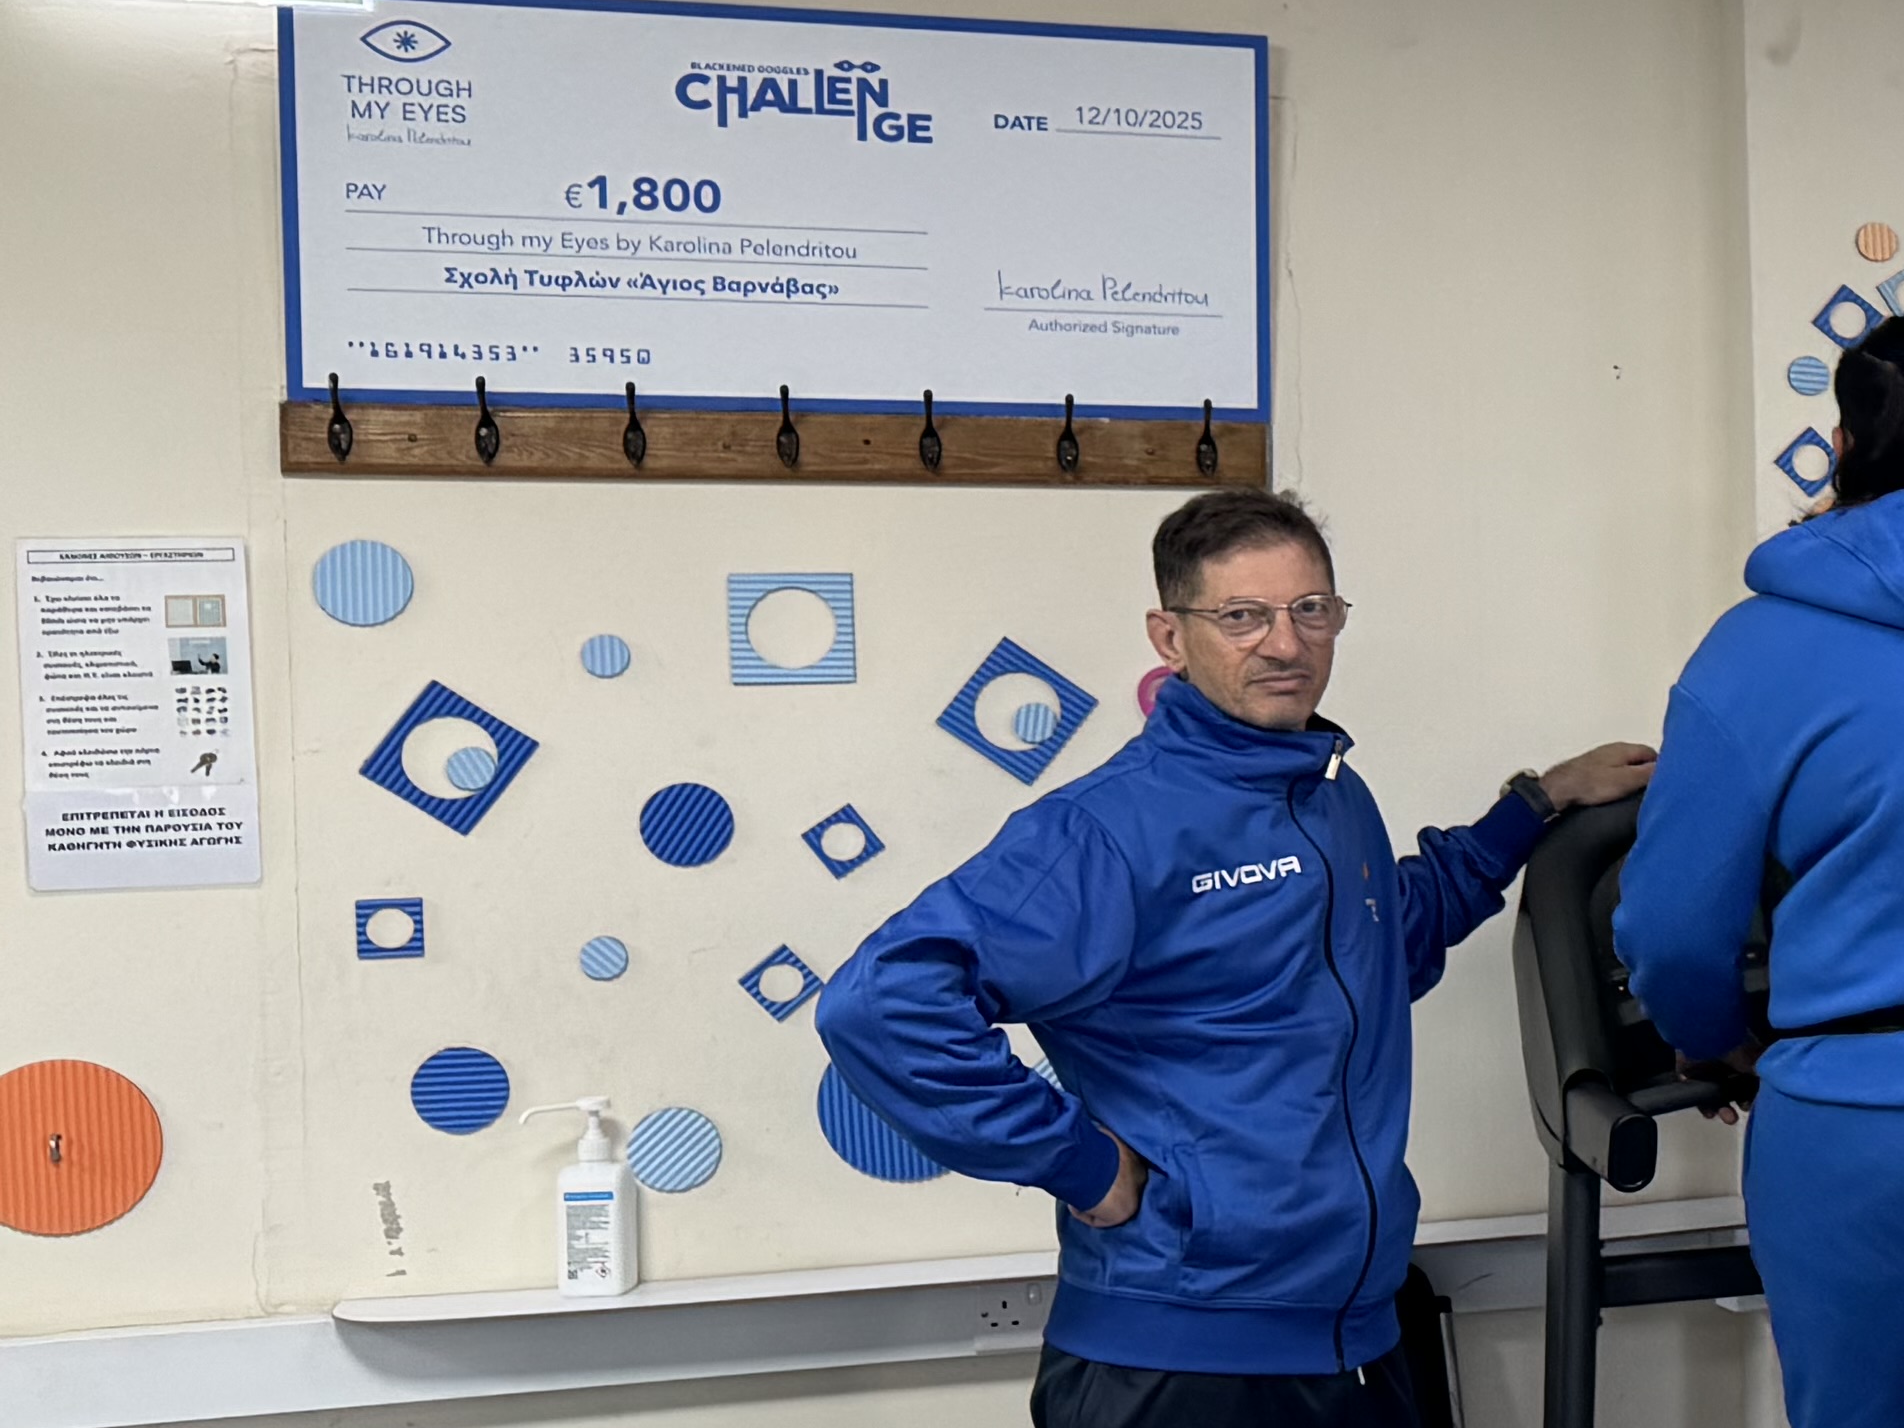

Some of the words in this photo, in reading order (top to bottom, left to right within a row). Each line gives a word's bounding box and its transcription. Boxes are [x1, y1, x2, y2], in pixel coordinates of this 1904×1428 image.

[341, 74, 472, 99] THROUGH
[351, 100, 390, 120] MY
[402, 102, 467, 123] EYES
[993, 113, 1049, 132] DATE
[1075, 106, 1204, 131] 12/10/2025
[345, 183, 387, 200] PAY
[564, 175, 722, 216] €1,800
[422, 226, 514, 251] Through
[521, 236, 553, 253] my
[561, 232, 610, 253] Eyes
[616, 233, 641, 256] by
[649, 234, 732, 256] Karolina
[740, 238, 858, 260] Pelendritou
[444, 267, 518, 291] Σχολή
[524, 269, 621, 292] Τυφλών
[1028, 318, 1108, 334] Authorized
[1112, 321, 1181, 338] Signature
[168, 807, 227, 818] ΕΙΣΟΔΟΣ
[45, 827, 86, 837] ΜΟΝΟ
[145, 822, 213, 834] ΠΑΡΟΥΣΙΑ
[216, 821, 243, 831] ΤΟΥ
[1191, 855, 1302, 894] GIVOVA
